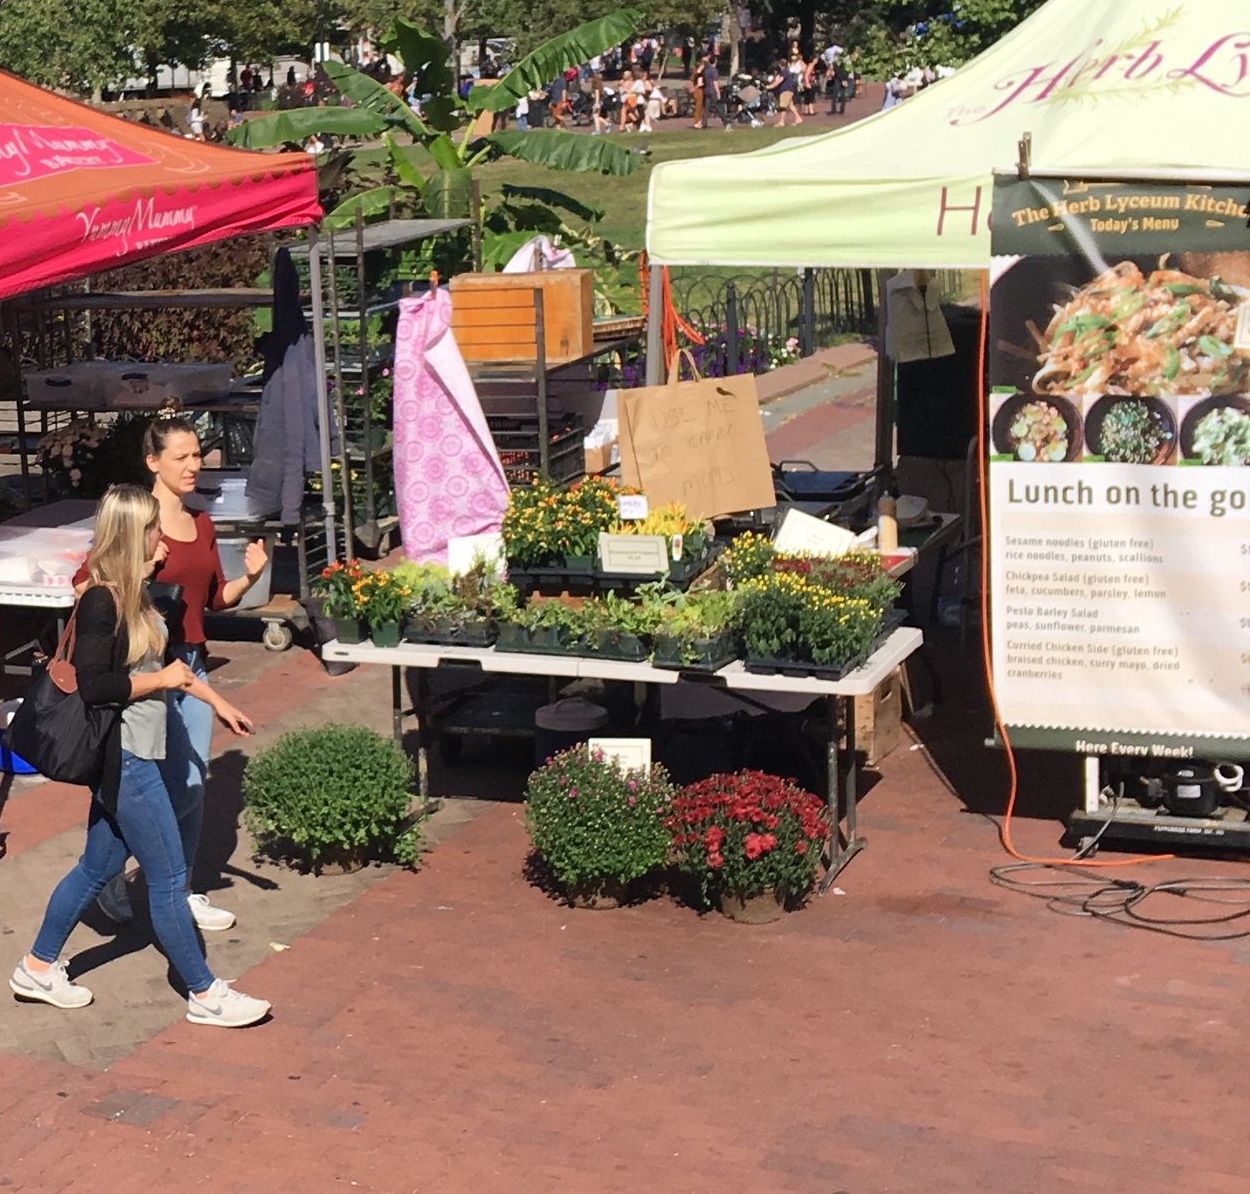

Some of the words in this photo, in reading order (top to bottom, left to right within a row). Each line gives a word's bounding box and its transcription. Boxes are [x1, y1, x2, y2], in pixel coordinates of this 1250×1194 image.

[950, 38, 1164, 126] Herb
[1012, 207, 1049, 227] The
[1053, 195, 1101, 217] Herb
[1105, 193, 1180, 214] Lyceum
[1090, 216, 1139, 234] Today's
[1142, 217, 1179, 231] Menu
[652, 406, 696, 433] USE
[706, 397, 736, 415] ME
[1008, 479, 1093, 504] Lunch
[1106, 485, 1141, 505] on
[1151, 483, 1198, 509] the
[1210, 488, 1246, 517] go
[1006, 536, 1043, 546] Sesame
[1046, 537, 1085, 548] noodles
[1088, 538, 1126, 550] (gluten
[1129, 539, 1154, 550] free)
[1006, 551, 1024, 560] rice
[1026, 551, 1068, 562] noodles,
[1072, 553, 1116, 564] peanuts,
[1119, 553, 1164, 564] scallions
[1006, 570, 1050, 583] Chickpea
[1052, 572, 1080, 583] Salad
[1083, 573, 1121, 585] (gluten
[1124, 574, 1149, 585] free)
[1031, 586, 1087, 598] cucumbers,
[1090, 588, 1131, 600] parsley,
[1134, 588, 1167, 598] lemon
[1006, 606, 1034, 616] Pesto
[1037, 607, 1068, 619] Barley
[1071, 608, 1099, 618] Salad
[1006, 620, 1032, 631] peas,
[1035, 620, 1087, 632] sunflower,
[1090, 624, 1140, 634] parmesan
[1007, 640, 1042, 651] Curried
[1045, 641, 1084, 653] Chicken
[1087, 643, 1109, 654] Side
[1112, 644, 1150, 657] (gluten
[1153, 645, 1179, 657] free)
[1007, 654, 1043, 665] braised
[1046, 655, 1087, 667] chicken,
[1090, 658, 1116, 670] curry
[1119, 660, 1150, 671] mayo,
[1153, 660, 1180, 670] dried
[1007, 668, 1063, 679] cranberries
[1075, 740, 1107, 753] Here
[1110, 742, 1148, 755] Every
[1152, 744, 1194, 758] Week!
